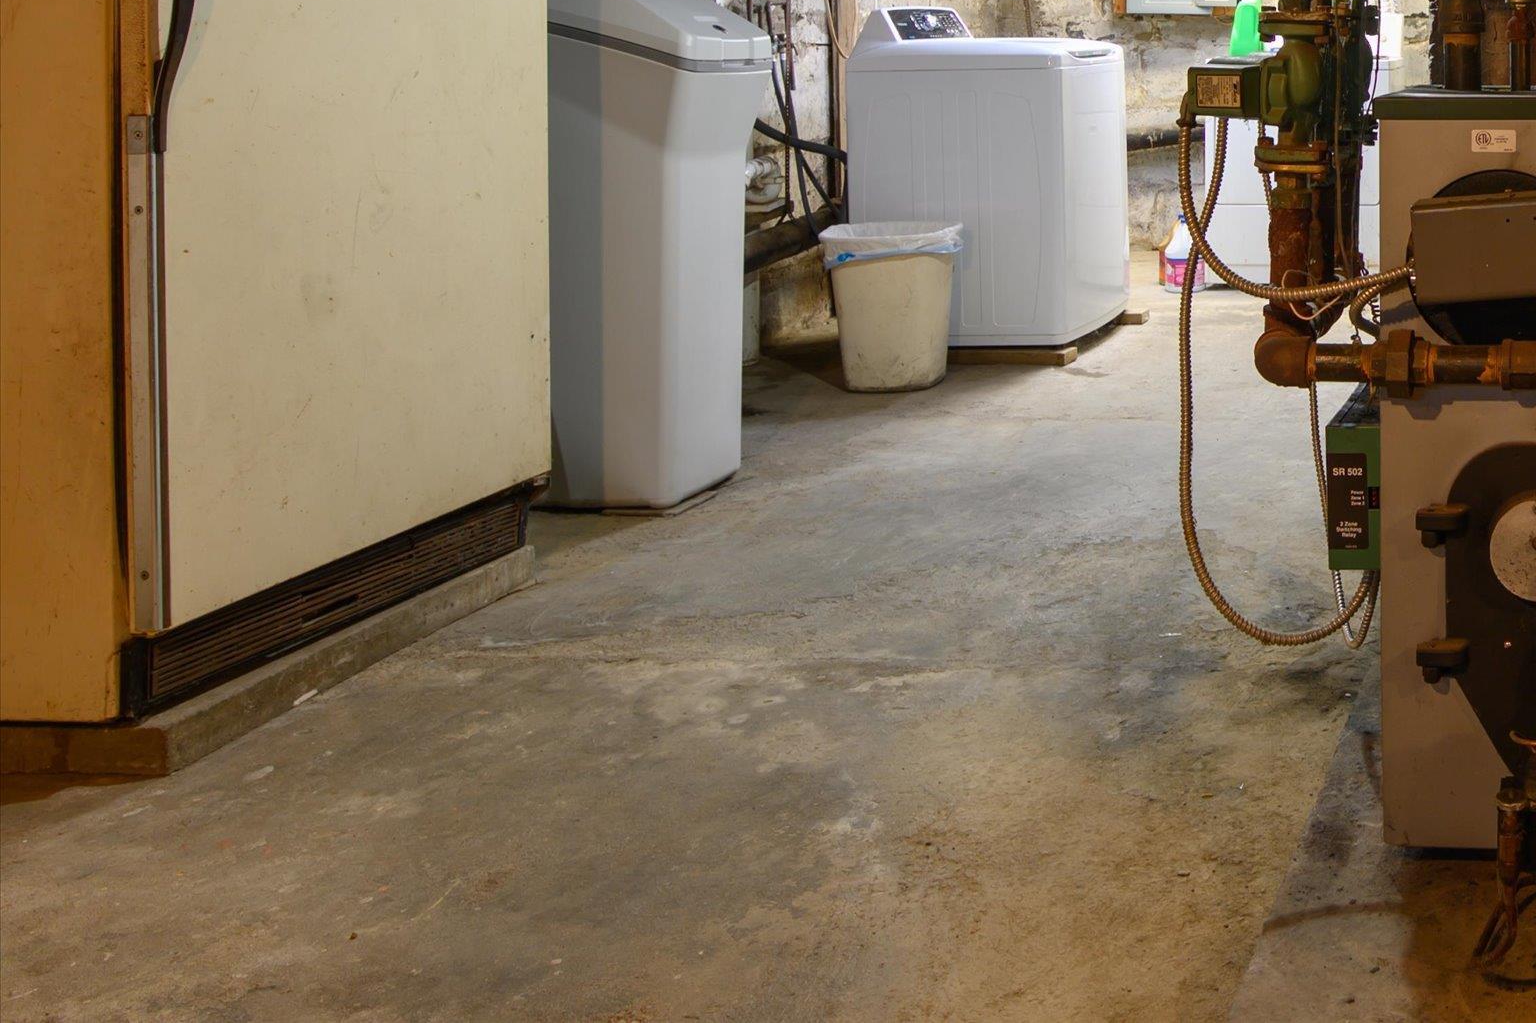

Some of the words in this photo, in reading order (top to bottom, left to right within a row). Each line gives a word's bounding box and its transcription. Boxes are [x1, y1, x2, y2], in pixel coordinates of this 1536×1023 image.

[1477, 133, 1489, 144] ETL
[1332, 467, 1346, 477] SR
[1347, 467, 1363, 477] 502
